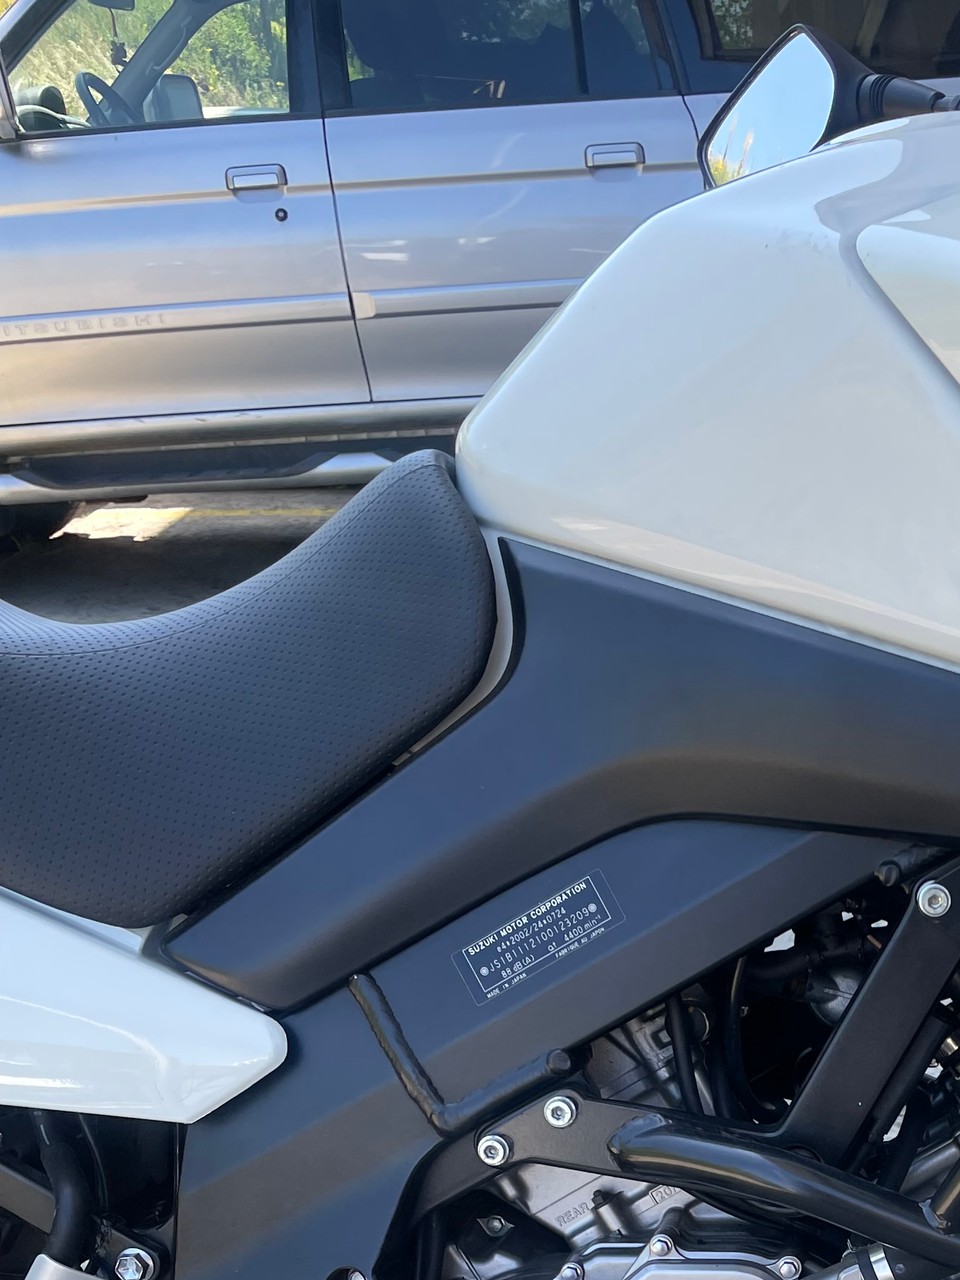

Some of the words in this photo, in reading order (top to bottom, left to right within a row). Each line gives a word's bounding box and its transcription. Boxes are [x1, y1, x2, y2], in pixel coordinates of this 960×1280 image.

[468, 935, 499, 956] SUZUKI
[500, 916, 529, 938] MOTOR
[530, 881, 587, 919] CORPORATION
[555, 942, 580, 959] FABRIQUE
[589, 927, 605, 940] JAPON
[563, 926, 584, 942] 4400
[487, 988, 501, 999] MADE
[511, 972, 527, 985] JAPAN
[555, 1202, 590, 1227] REAR
